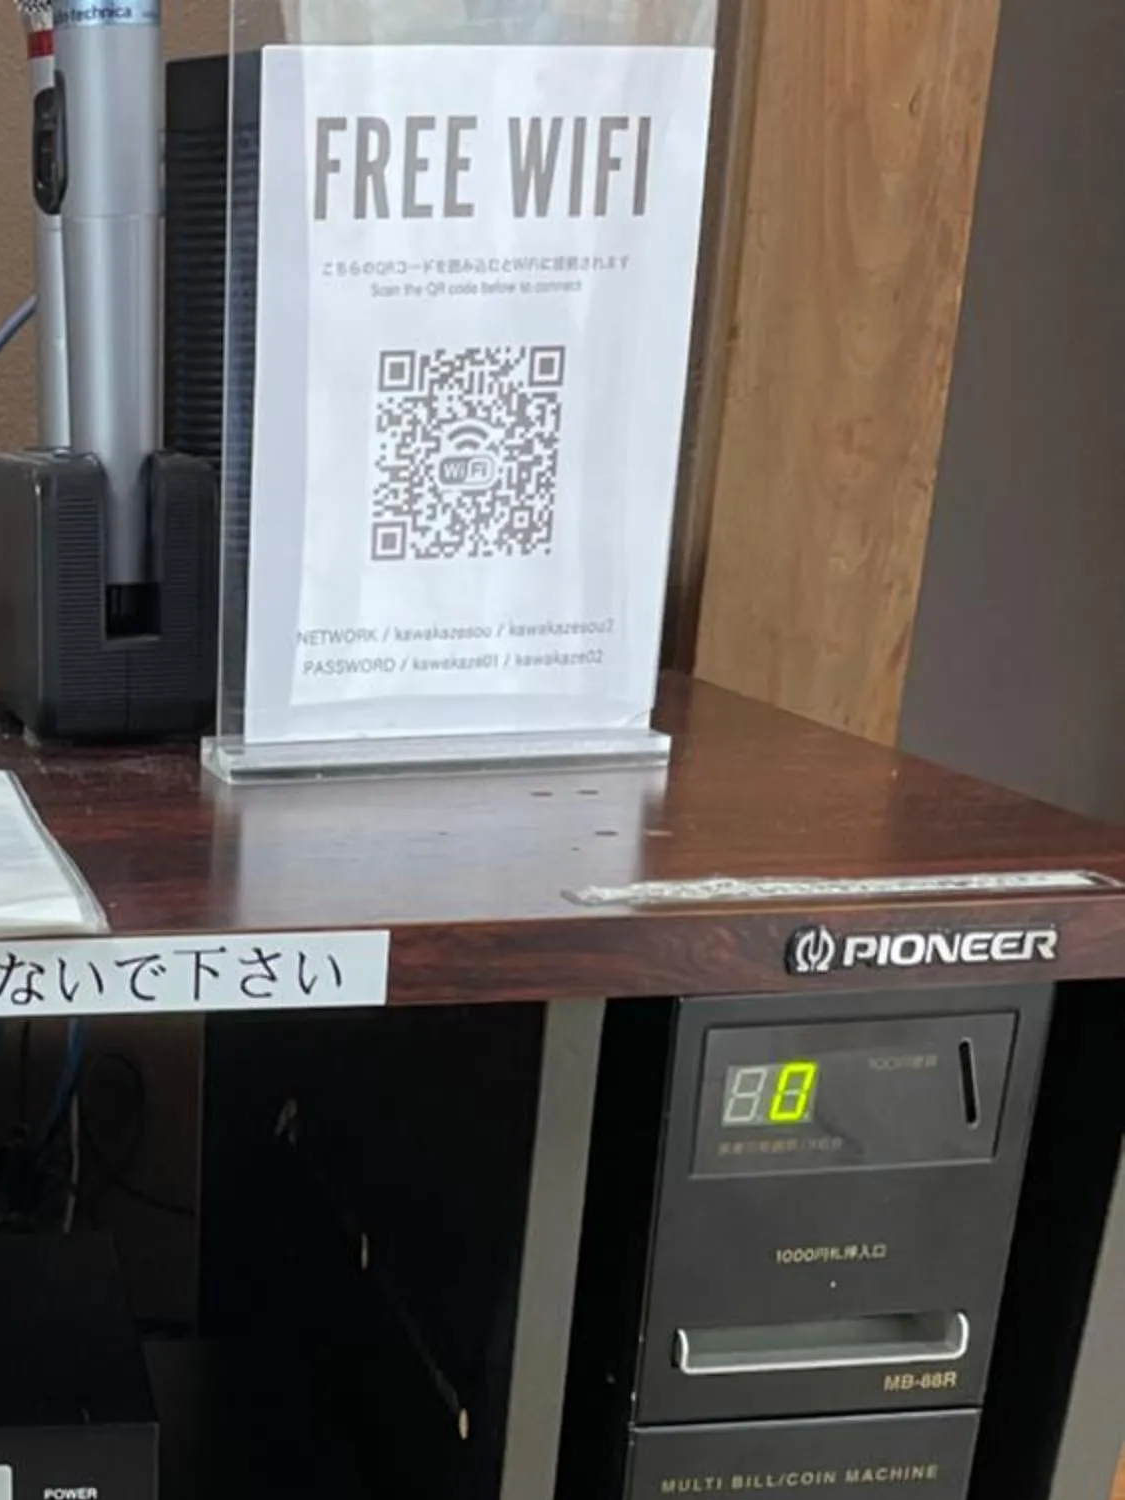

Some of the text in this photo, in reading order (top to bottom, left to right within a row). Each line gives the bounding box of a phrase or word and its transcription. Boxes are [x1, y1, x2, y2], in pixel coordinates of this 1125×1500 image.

[313, 115, 652, 221] FREE WIFI
[370, 279, 582, 298] Scan the QR code below to connect
[296, 629, 379, 646] NETWORK
[393, 624, 492, 642] kawakazesou
[302, 658, 396, 676] PASSWORD
[412, 655, 499, 672] kawakaze01
[514, 649, 604, 668] kawakaze02
[841, 929, 1058, 968] PIONEER
[768, 1061, 819, 1123] 0
[43, 1486, 98, 1500] POWER
[660, 1463, 939, 1494] MULTI BILL/COIN MACHINE
